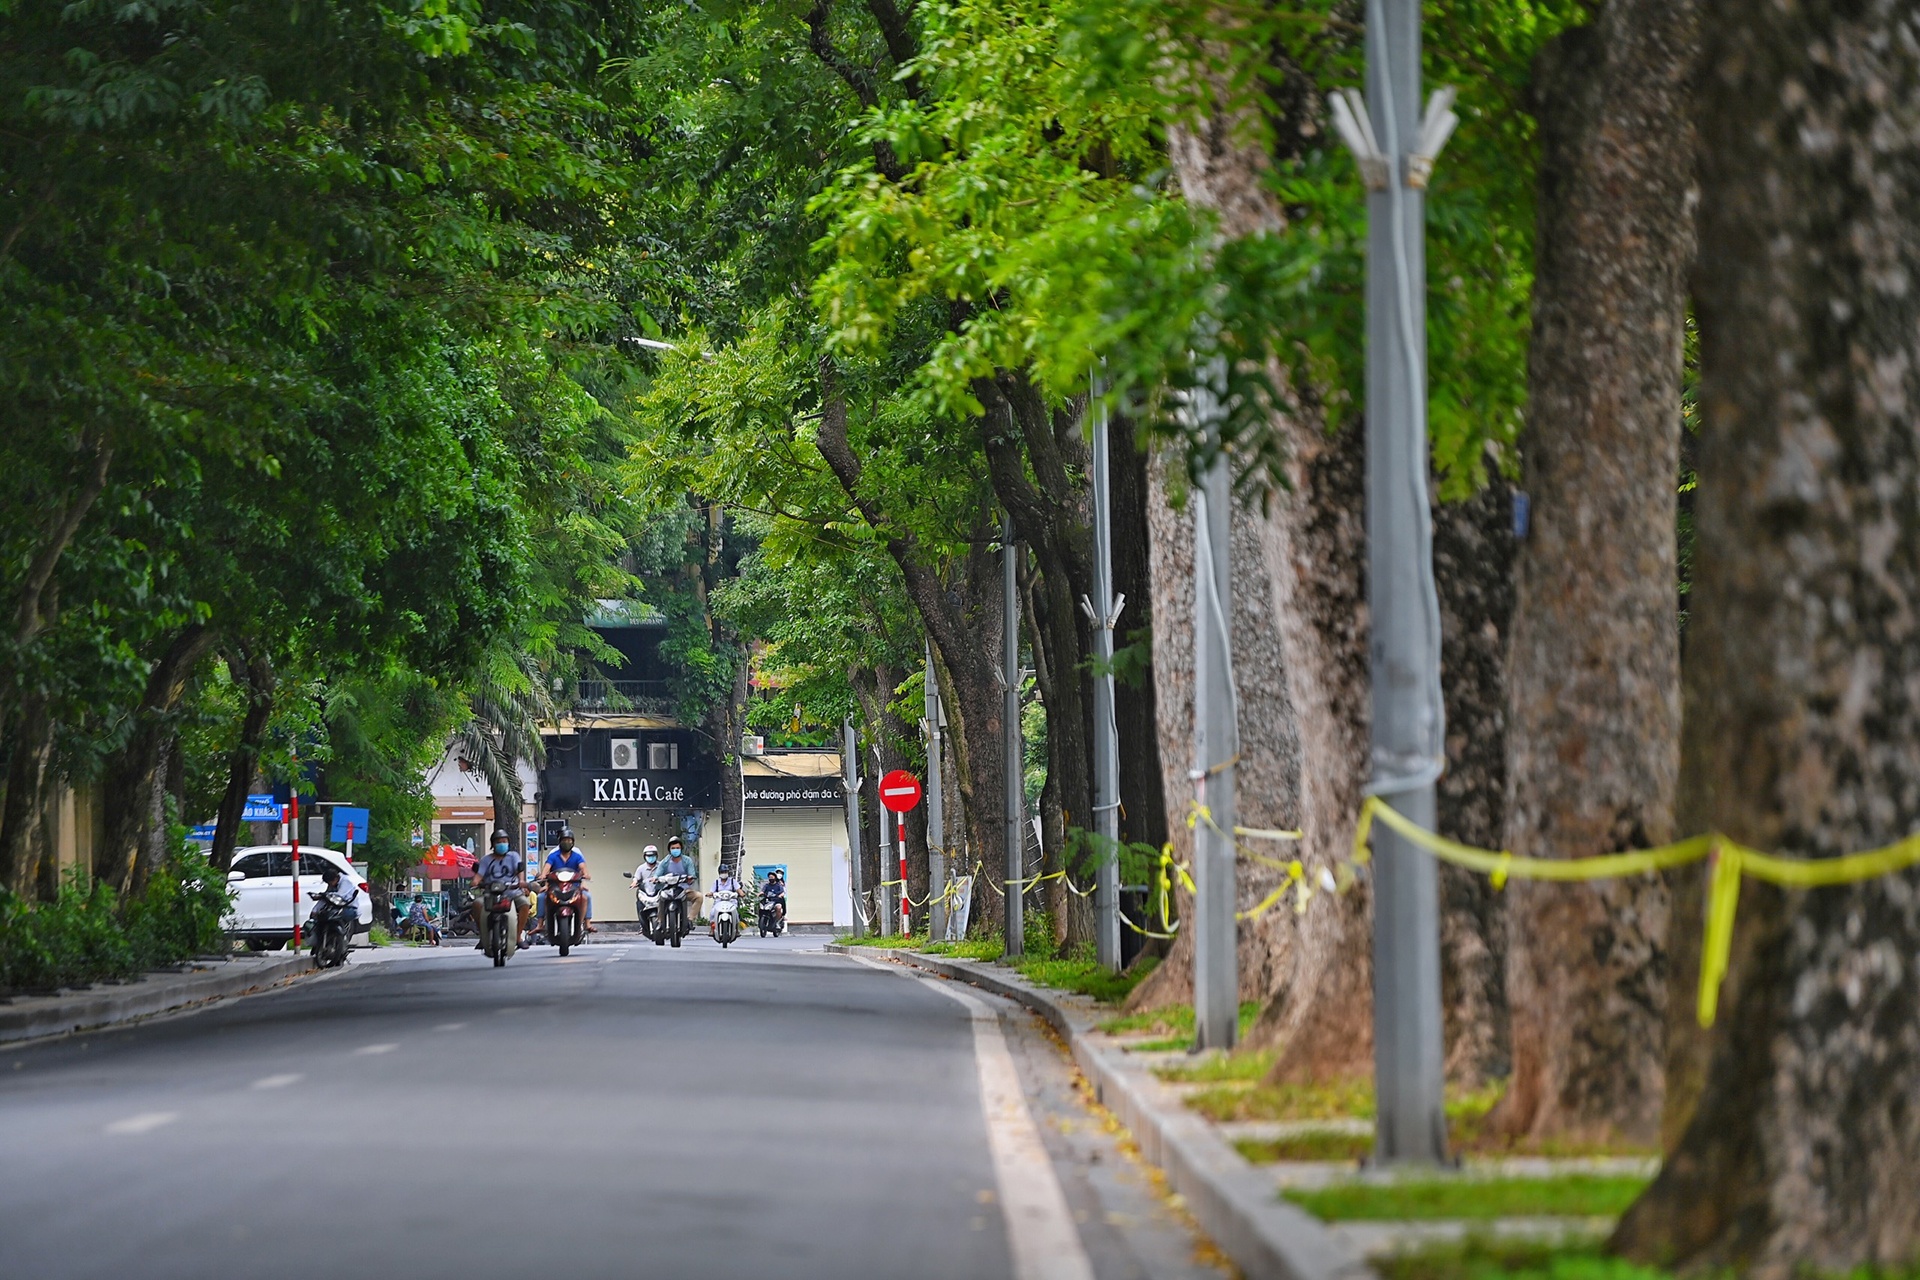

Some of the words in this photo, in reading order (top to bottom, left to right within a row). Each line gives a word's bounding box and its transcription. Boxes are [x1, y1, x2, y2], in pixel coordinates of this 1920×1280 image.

[593, 778, 653, 800] KAFA
[654, 786, 684, 801] Café
[760, 789, 784, 801] đường
[786, 788, 801, 801] phố
[821, 789, 832, 799] đà
